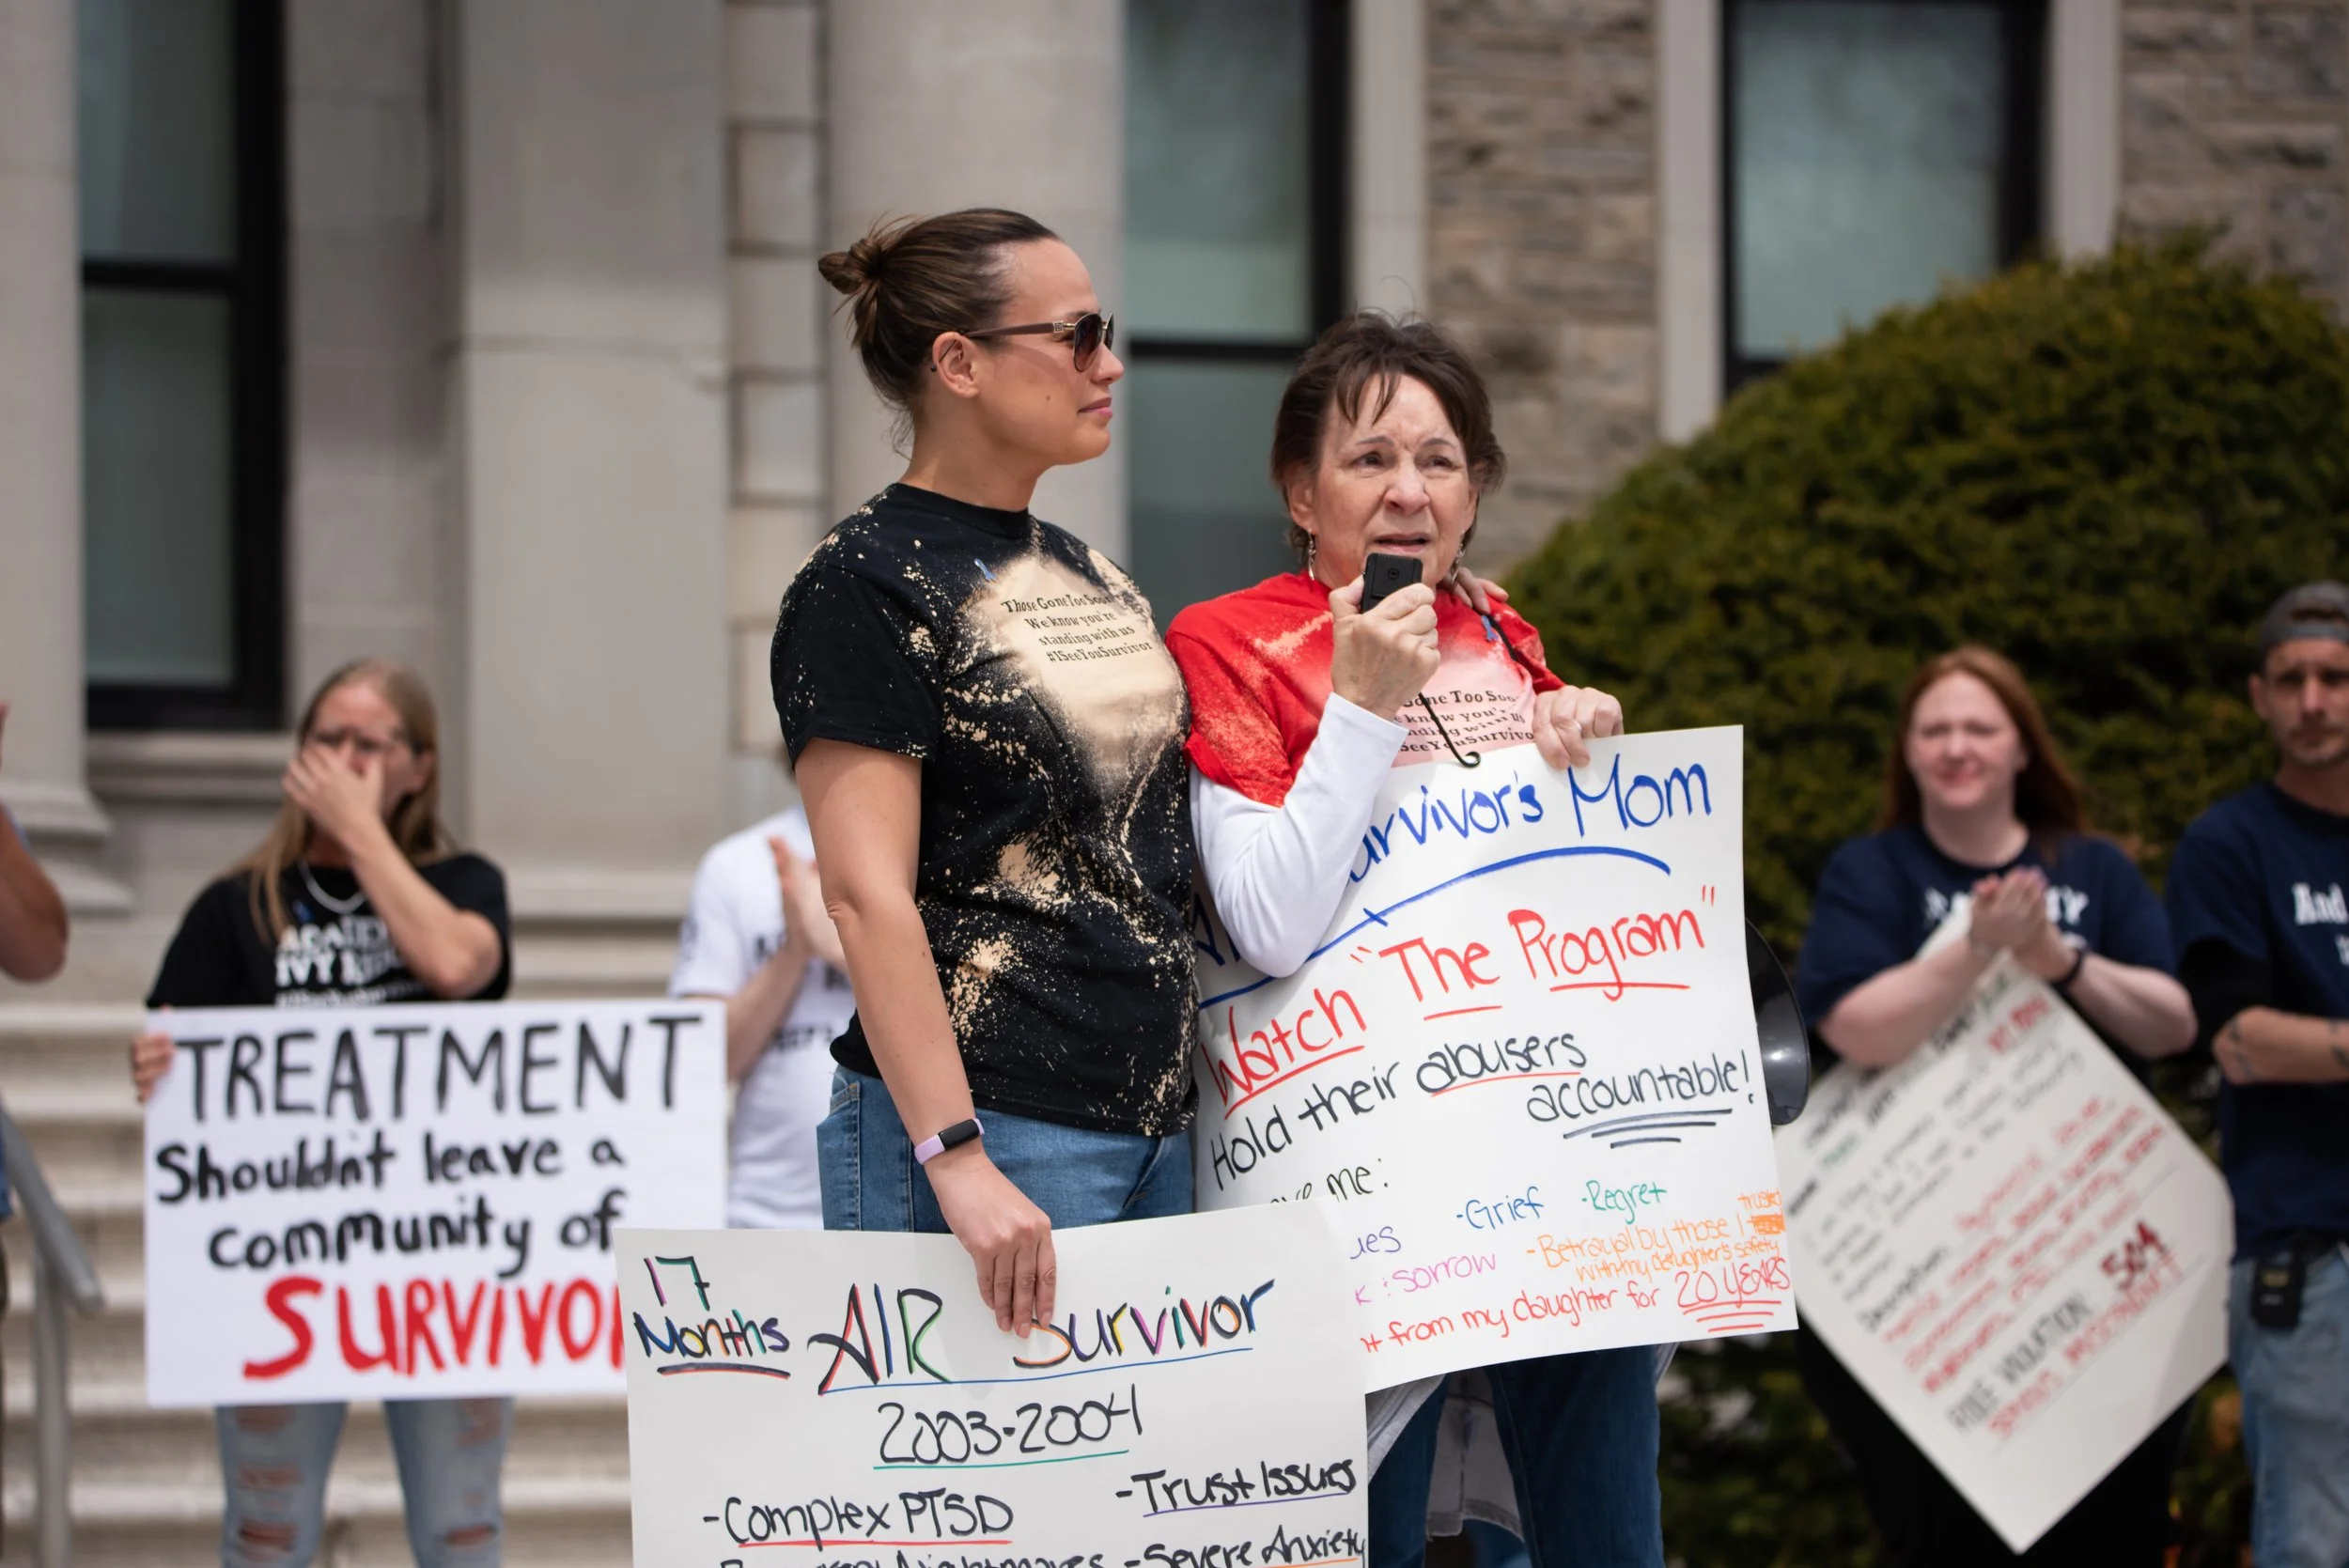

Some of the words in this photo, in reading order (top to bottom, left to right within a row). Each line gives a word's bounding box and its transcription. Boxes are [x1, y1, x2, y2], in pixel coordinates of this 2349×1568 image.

[1001, 599, 1038, 613] Those
[1036, 597, 1068, 610] Gone
[1066, 594, 1087, 607] Too
[1024, 617, 1050, 629] We
[1047, 615, 1080, 627] know
[1080, 611, 1117, 627] you're
[1039, 631, 1093, 646] standing
[1093, 628, 1120, 642] with
[1121, 626, 1135, 637] us
[1046, 641, 1153, 663] #ISeeYouSurvivor
[1450, 690, 1483, 703] Too
[1347, 769, 1544, 882] urvivor's
[1568, 753, 1713, 838] Mom
[1202, 988, 1367, 1108] Watch
[1350, 937, 1501, 1002] "The
[1508, 885, 1717, 1001] Program"
[175, 1016, 704, 1123] TREATMENT
[1527, 1049, 1755, 1123] accountable!
[1210, 1105, 1292, 1191] Hold
[1299, 1060, 1402, 1131] their
[1417, 1032, 1588, 1094] abusers
[425, 1132, 564, 1185] leave
[591, 1139, 624, 1166] a
[208, 1194, 531, 1281] community
[559, 1188, 628, 1252] of
[1576, 1259, 1617, 1282] with
[1618, 1257, 1653, 1282] my
[1651, 1242, 1732, 1274] daughter's
[1736, 1237, 1781, 1261] safety
[1635, 1224, 1669, 1259] by
[1672, 1218, 1731, 1245] those
[645, 1255, 710, 1312] 17
[1389, 1316, 1455, 1346] from
[1462, 1309, 1509, 1338] my
[1513, 1285, 1620, 1327] daughter
[1626, 1281, 1663, 1310] for
[1674, 1270, 1719, 1309] 20
[632, 1309, 790, 1358] Months
[807, 1282, 953, 1395] AIR
[1013, 1279, 1275, 1369] Survivor
[878, 1384, 1143, 1465] 2003-2004
[1261, 1459, 1357, 1498] Issues
[899, 1489, 1014, 1539] PTSD
[1262, 1525, 1366, 1568] Anxiety
